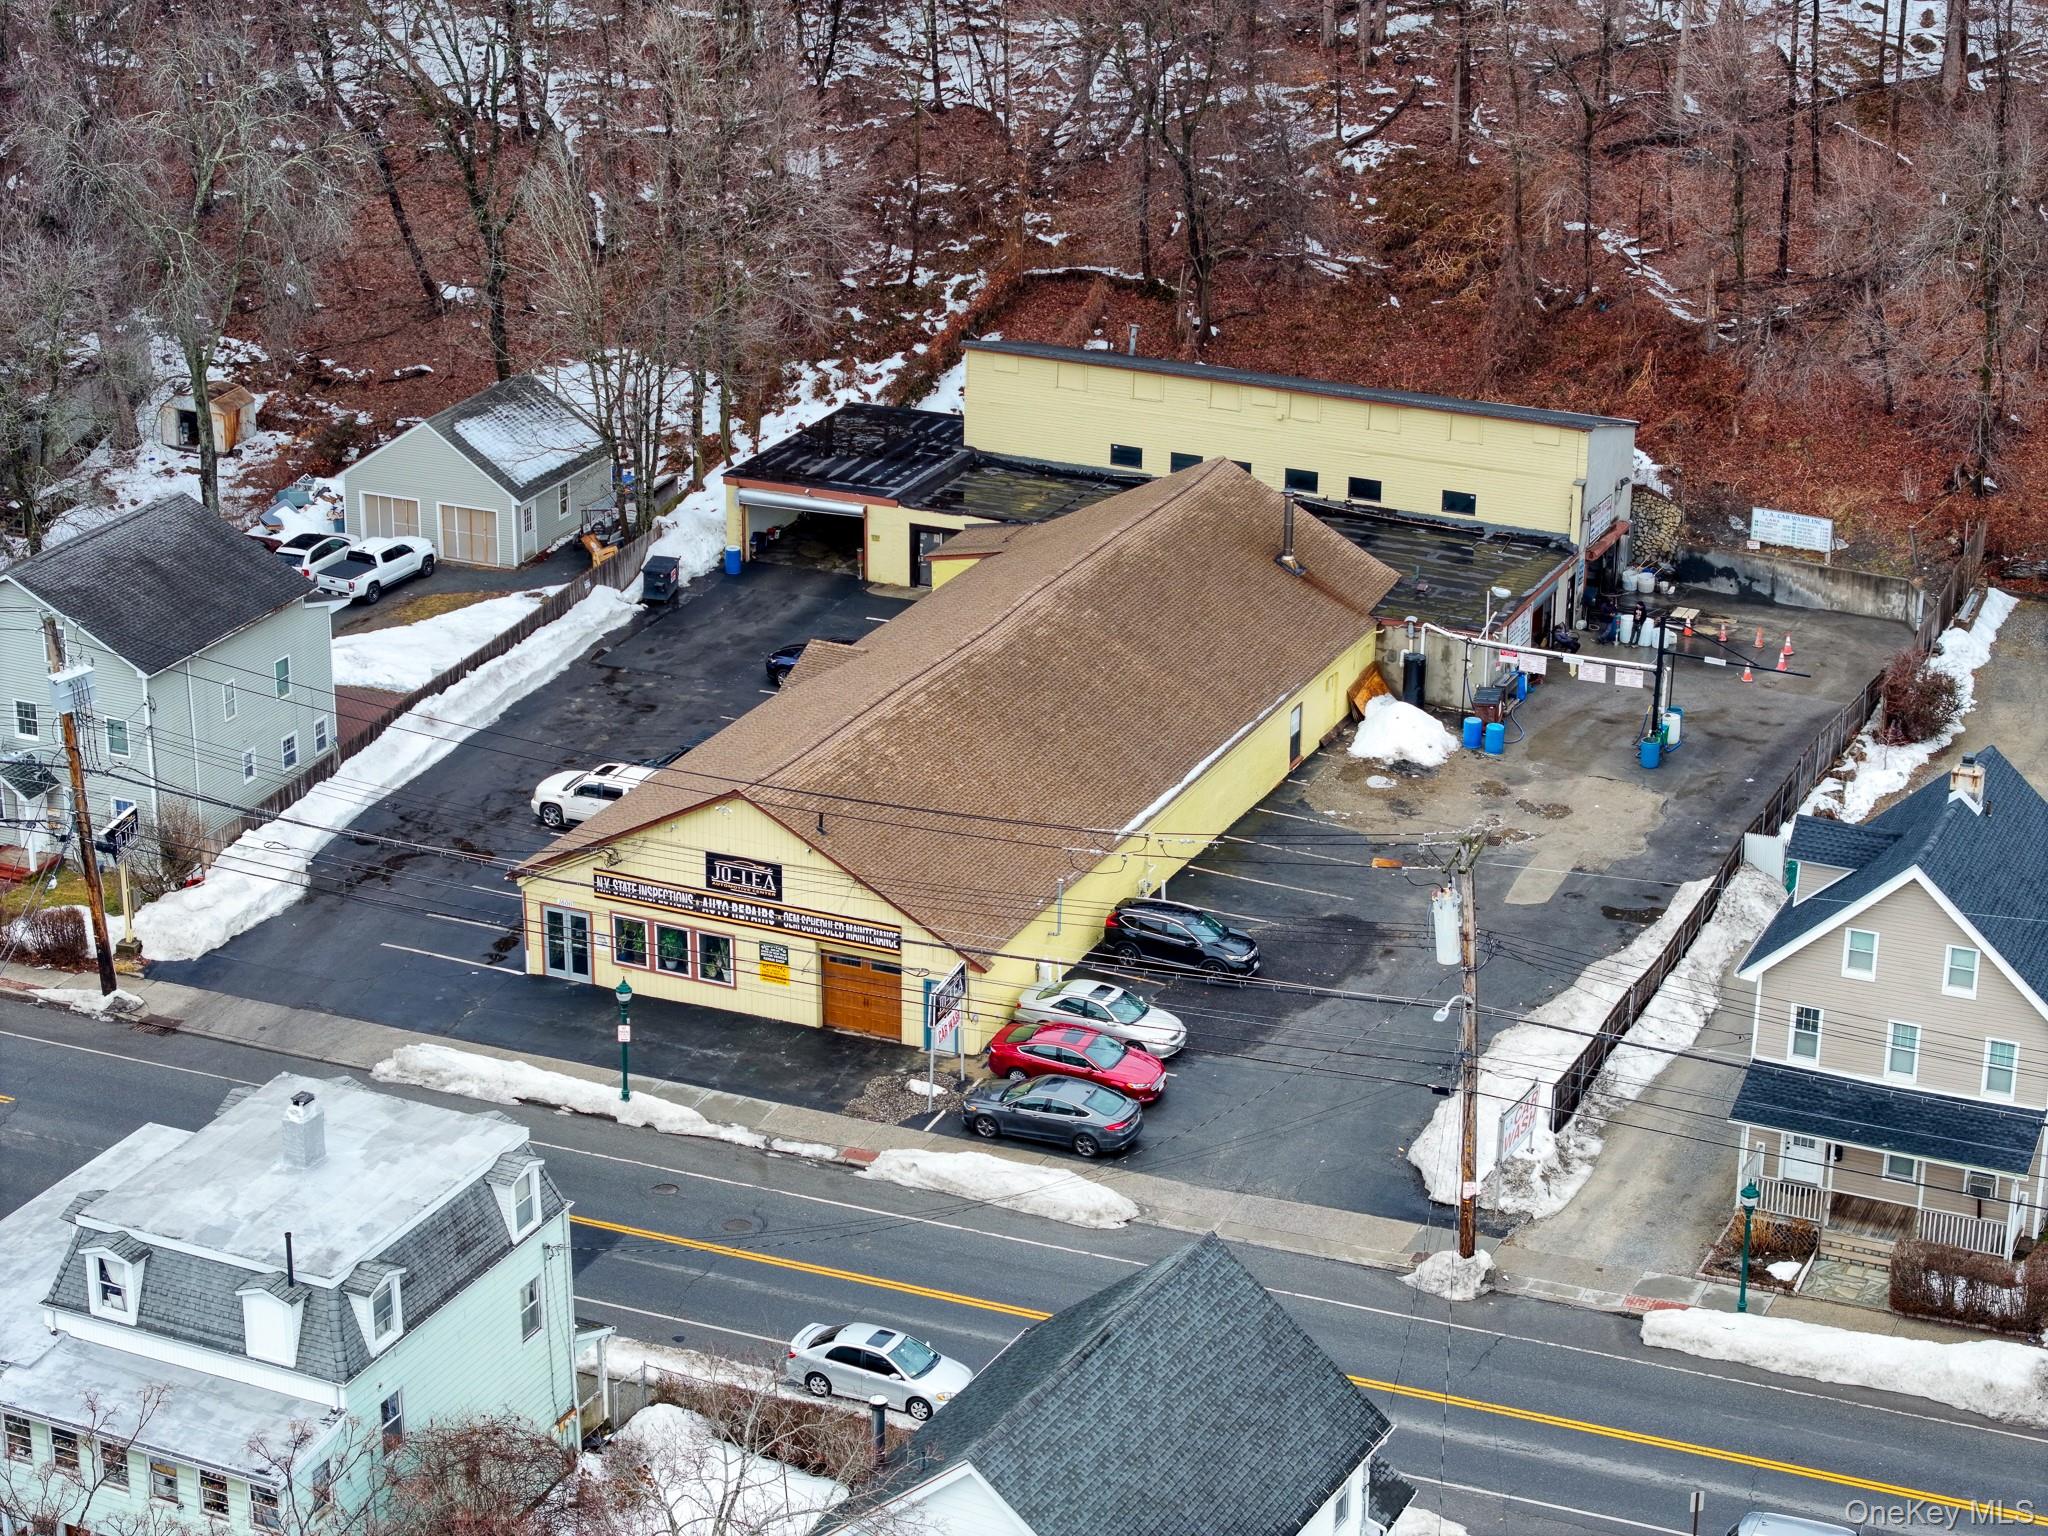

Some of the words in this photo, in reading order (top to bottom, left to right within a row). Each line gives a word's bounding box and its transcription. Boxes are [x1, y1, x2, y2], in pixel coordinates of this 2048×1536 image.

[711, 865, 777, 891] JO-LEA
[711, 881, 752, 892] AUTOMOTIVE
[752, 889, 776, 897] CENTER
[613, 878, 637, 899] STATE
[638, 884, 694, 910] INSPECTIONS
[702, 897, 729, 917] AUTO
[731, 902, 775, 926] REPAIRS
[783, 911, 800, 929] OEM
[801, 915, 844, 938] SCHEDULED
[846, 923, 899, 949] MAINTENANCE
[938, 1023, 948, 1043] CAR
[1515, 1090, 1538, 1124] CAR
[1504, 1108, 1536, 1152] WASH
